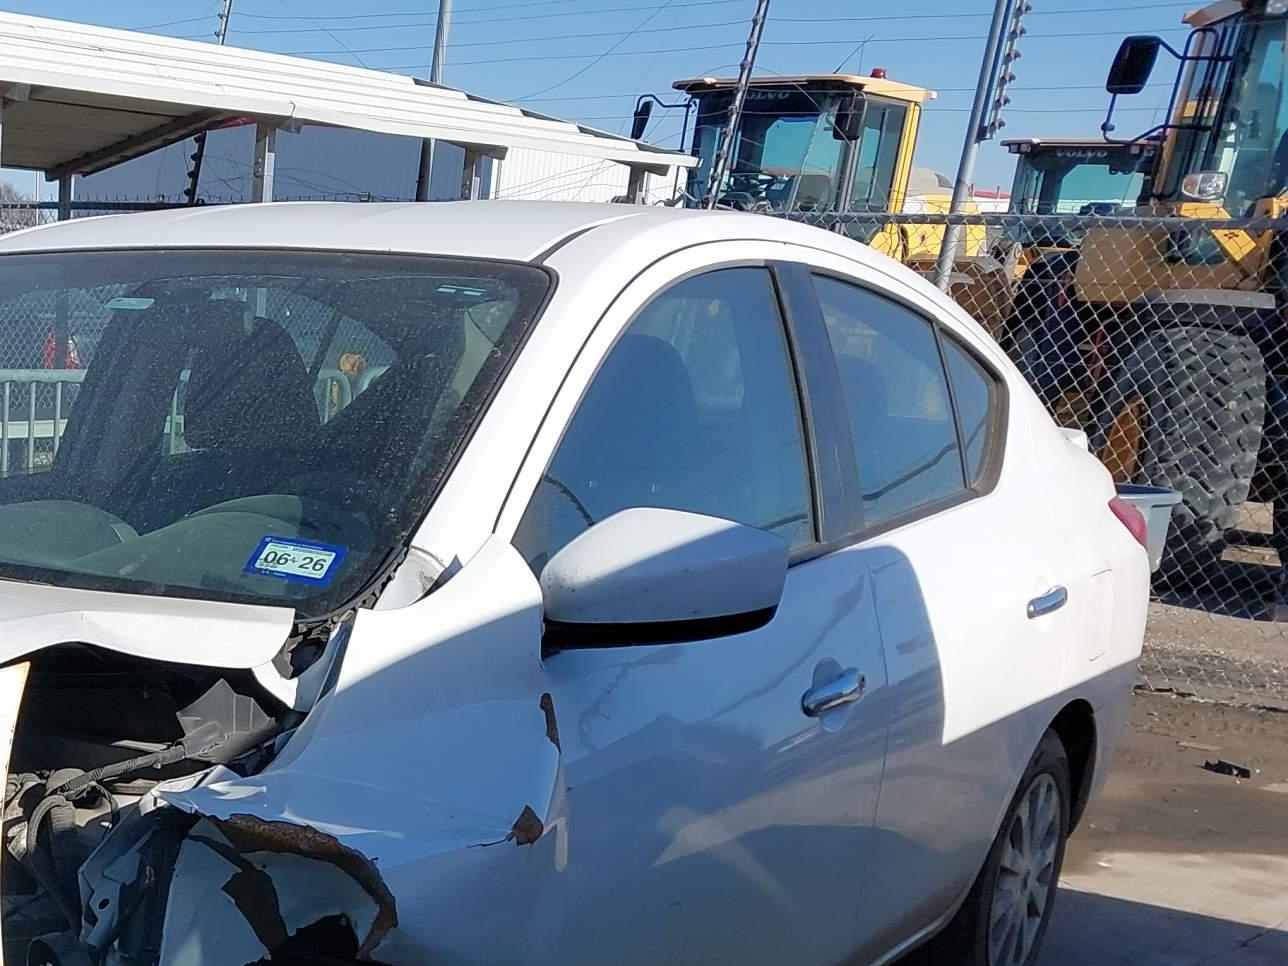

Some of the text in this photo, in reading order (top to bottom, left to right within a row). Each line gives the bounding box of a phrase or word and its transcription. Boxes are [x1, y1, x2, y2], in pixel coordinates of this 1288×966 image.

[1056, 149, 1108, 158] VOLVO
[263, 550, 291, 566] 06
[298, 556, 327, 572] 26
